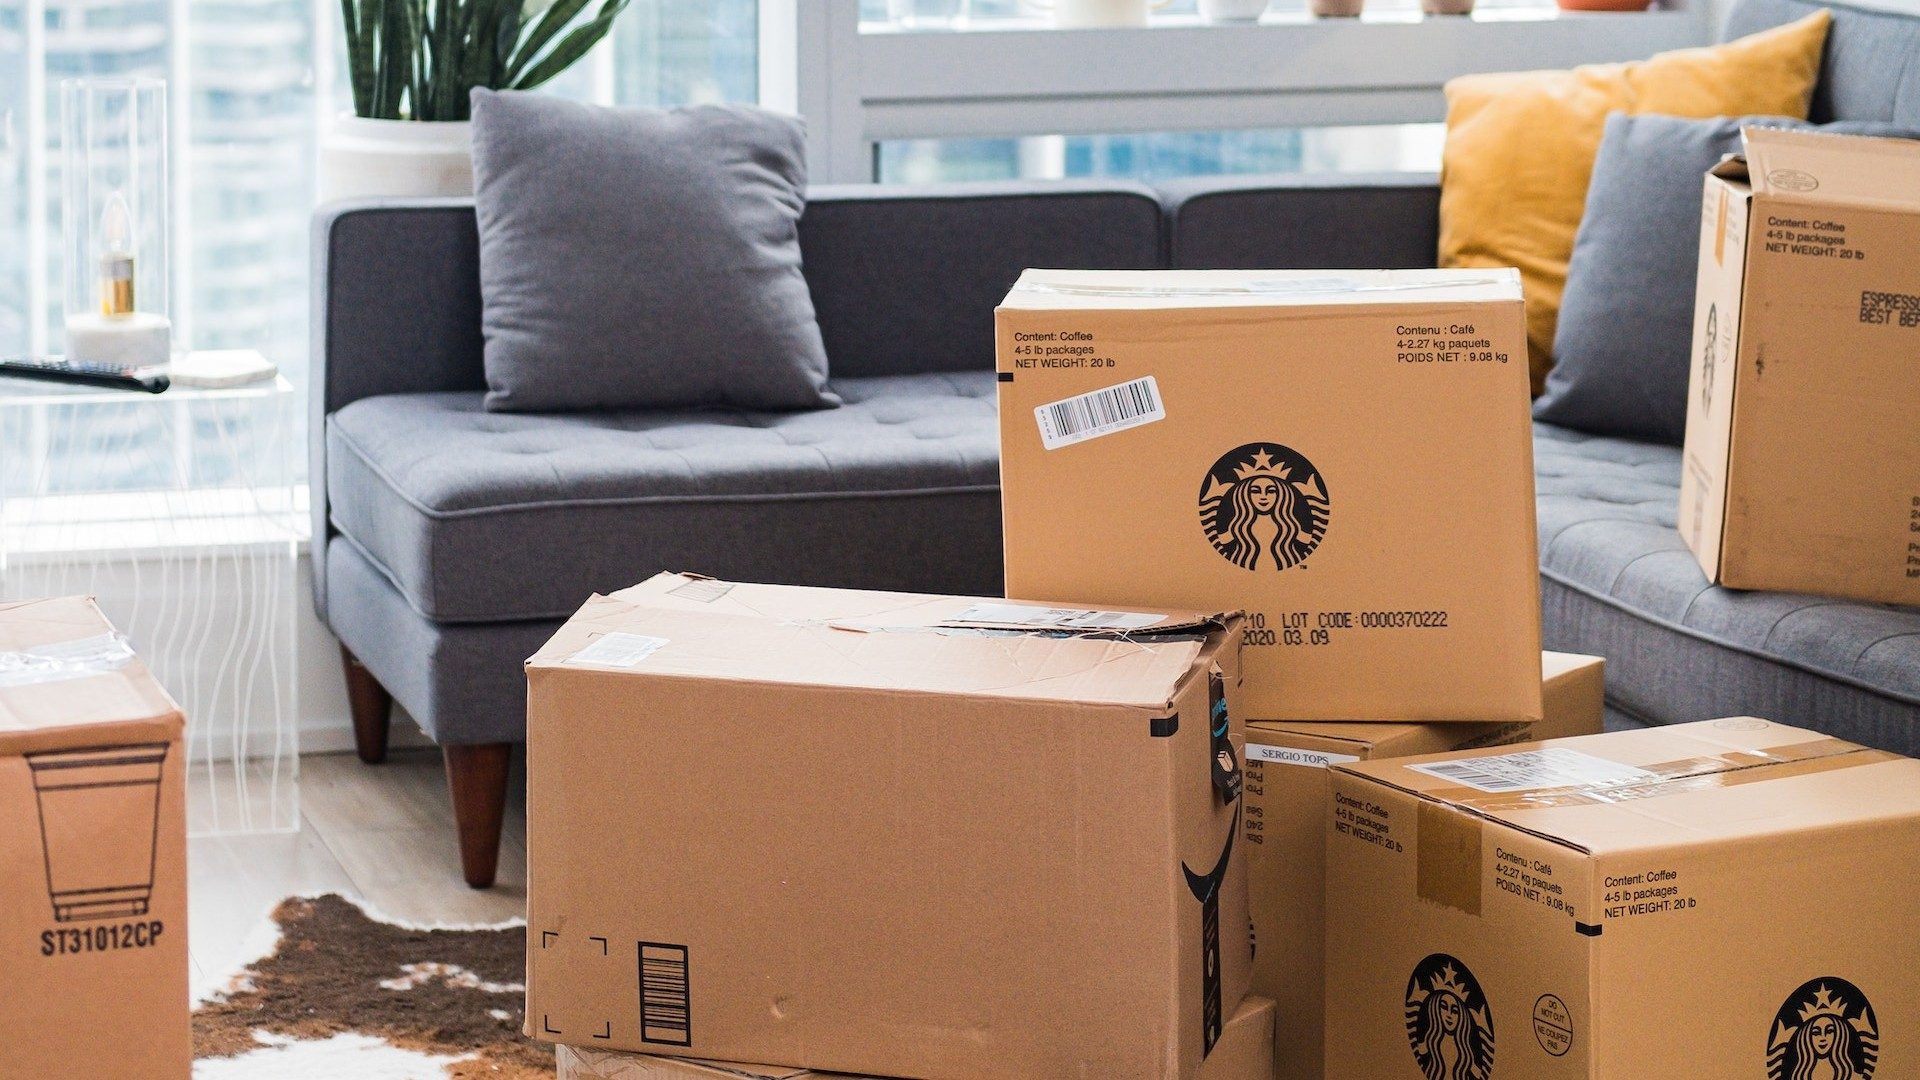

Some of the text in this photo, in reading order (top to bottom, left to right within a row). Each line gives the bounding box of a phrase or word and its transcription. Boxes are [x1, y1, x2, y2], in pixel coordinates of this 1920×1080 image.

[1766, 242, 1865, 260] NET WEIGHT: 20 lb
[1860, 308, 1892, 324] BEST
[1014, 331, 1093, 342] Content: Coffee
[1396, 325, 1440, 335] Contenu
[1450, 324, 1475, 335] Café
[1014, 345, 1094, 357] 4-5 lb packages
[1397, 339, 1490, 350] 4-2.27 kg paquets
[1015, 358, 1115, 368] NET WEIGHT: 20 lb
[1397, 352, 1434, 362] POIDS
[1437, 352, 1460, 362] NET
[1469, 352, 1492, 362] 9.08
[1495, 351, 1508, 363] kg
[1281, 612, 1308, 629] LOT
[1261, 748, 1329, 765] SERGIO TOPS
[1335, 820, 1351, 835] NET
[1385, 838, 1394, 850] 20
[1496, 847, 1527, 867] Contenu
[1534, 860, 1552, 876] Café
[1496, 863, 1563, 895] 4-2.27 kg paquets
[1604, 869, 1677, 888] Content: Coffee
[1496, 877, 1522, 896] POIDS
[1524, 887, 1540, 902] NET
[1565, 901, 1575, 917] kg
[1604, 885, 1678, 903] 4-5 lb packages
[1604, 897, 1697, 919] NET WEIGHT: 20 lb
[41, 920, 163, 956] ST31012CP
[1541, 1007, 1553, 1019] NOT
